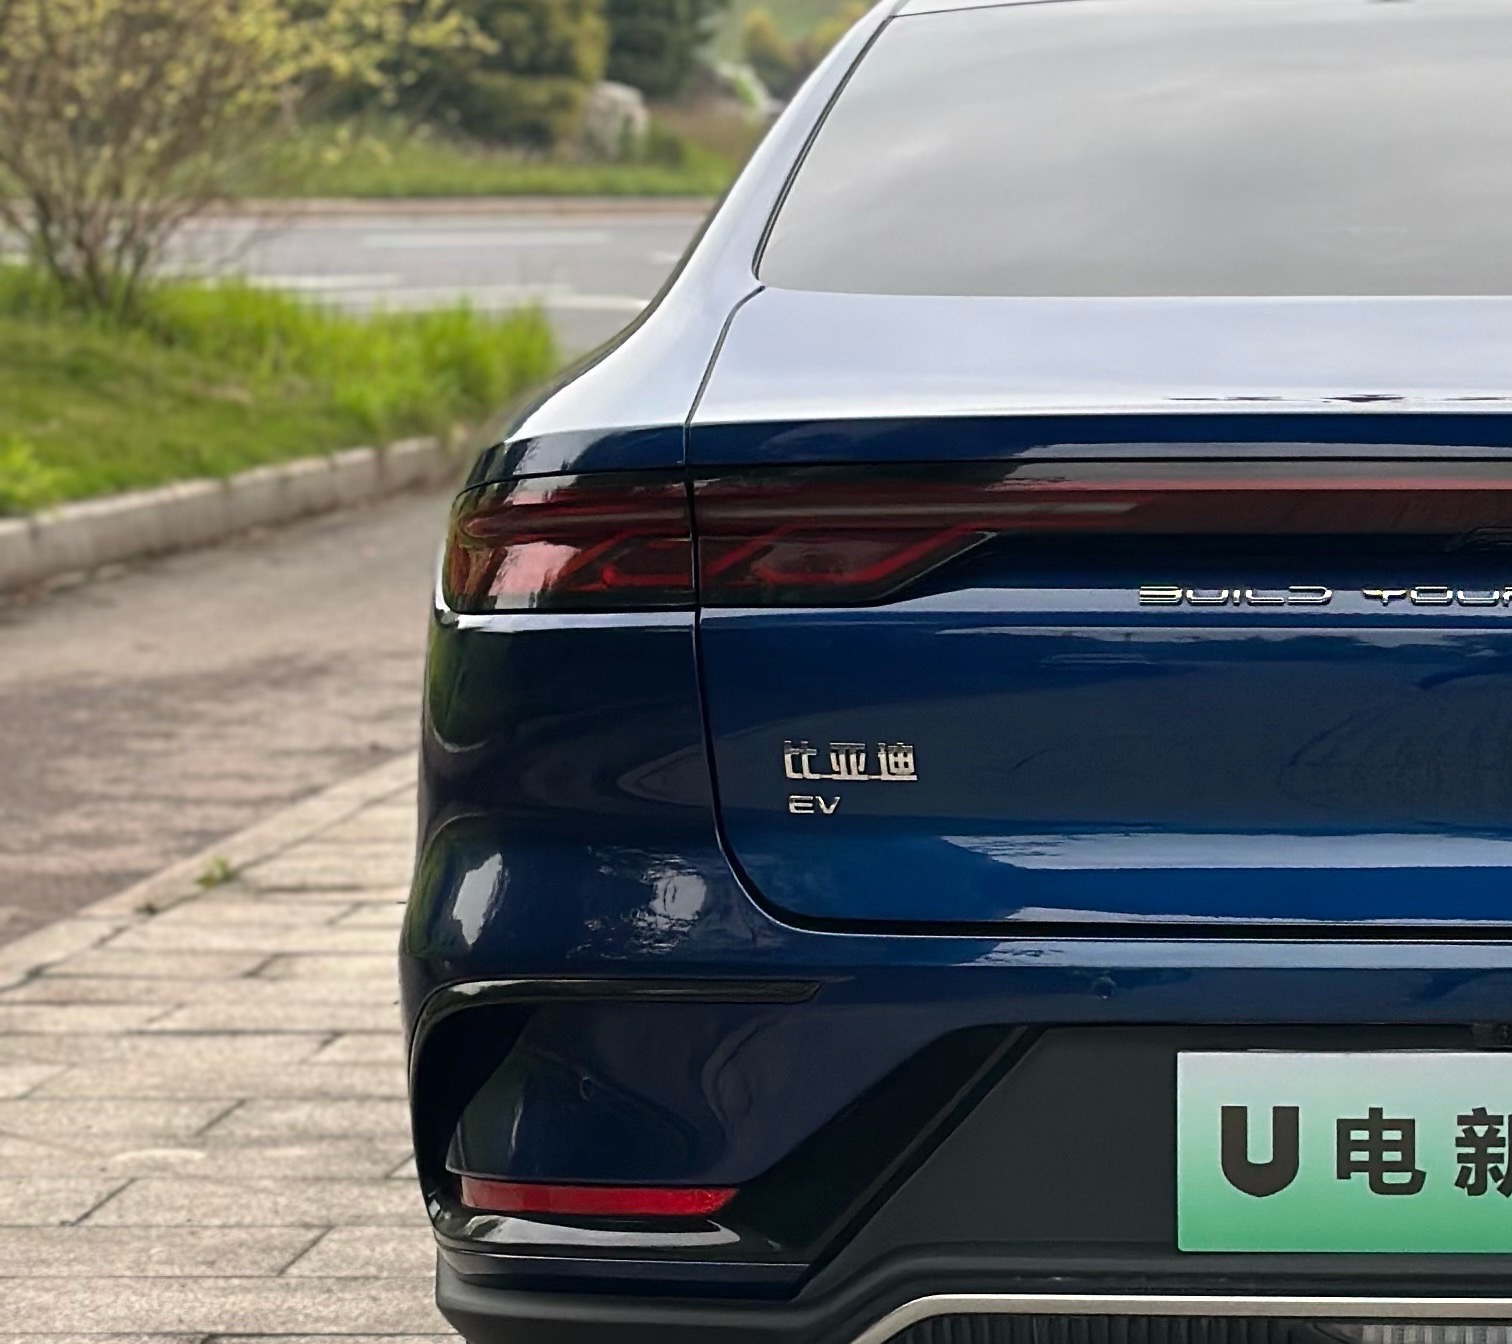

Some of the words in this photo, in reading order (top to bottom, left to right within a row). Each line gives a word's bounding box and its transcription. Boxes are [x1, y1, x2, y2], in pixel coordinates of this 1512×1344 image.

[1139, 586, 1333, 606] BUILD
[784, 740, 918, 780] 比亚迪
[789, 795, 841, 814] EV
